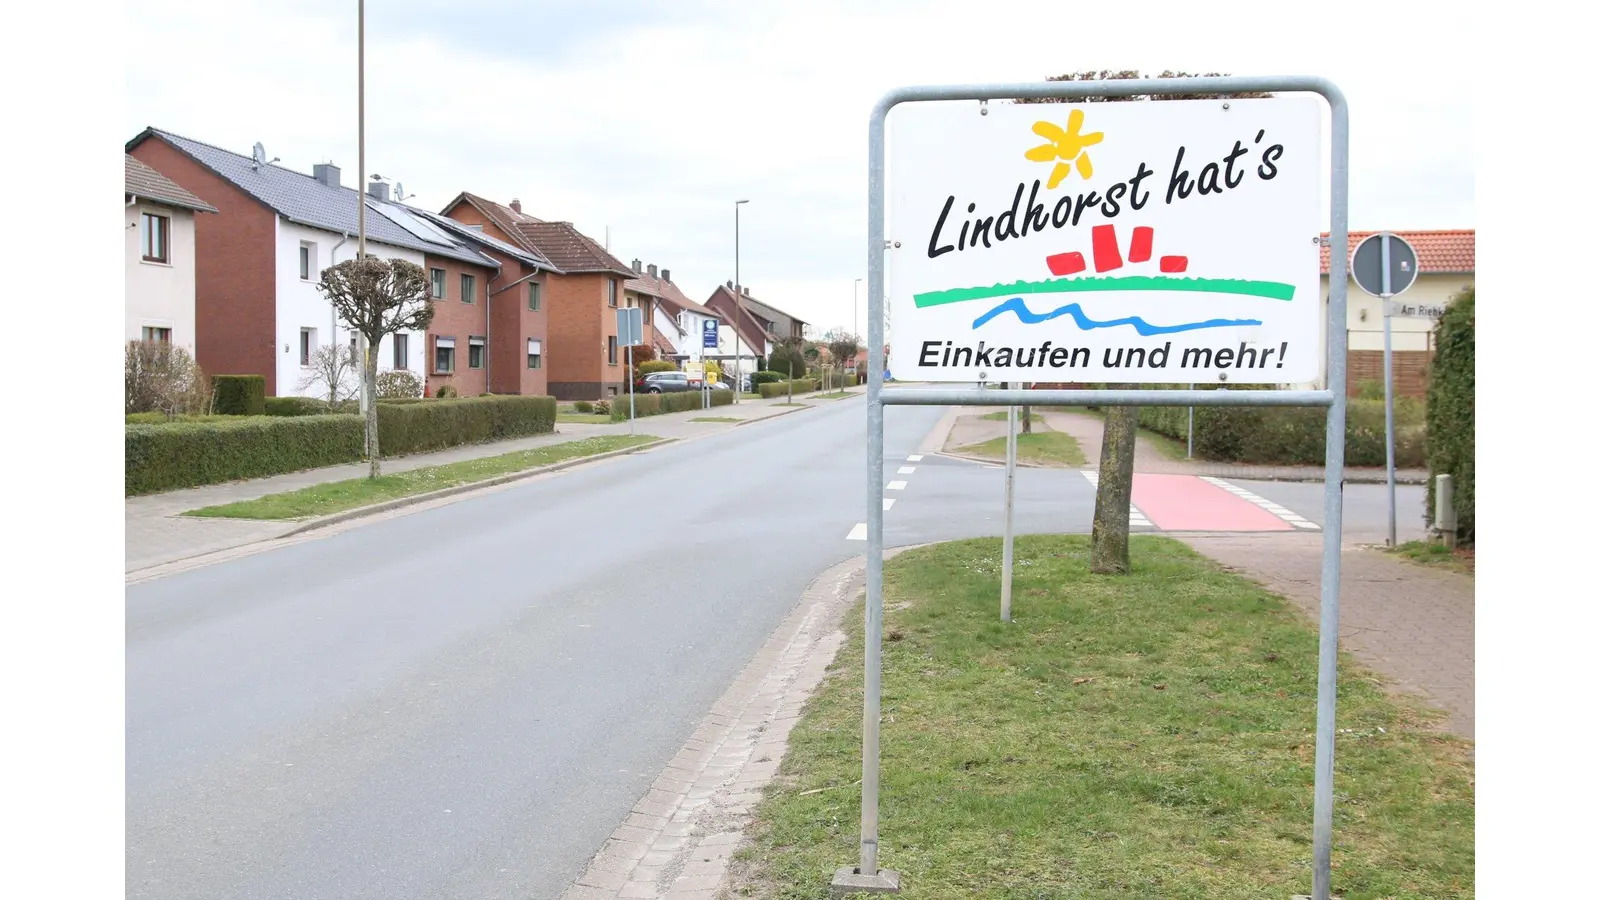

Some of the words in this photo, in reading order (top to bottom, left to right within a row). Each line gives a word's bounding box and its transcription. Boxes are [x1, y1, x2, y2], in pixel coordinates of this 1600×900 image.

[927, 162, 1154, 259] Lindhorst
[1165, 129, 1284, 205] hat's
[1400, 304, 1416, 316] Am
[918, 340, 1091, 368] Einkaufen
[1102, 341, 1172, 369] und
[1180, 341, 1288, 369] mehr!
